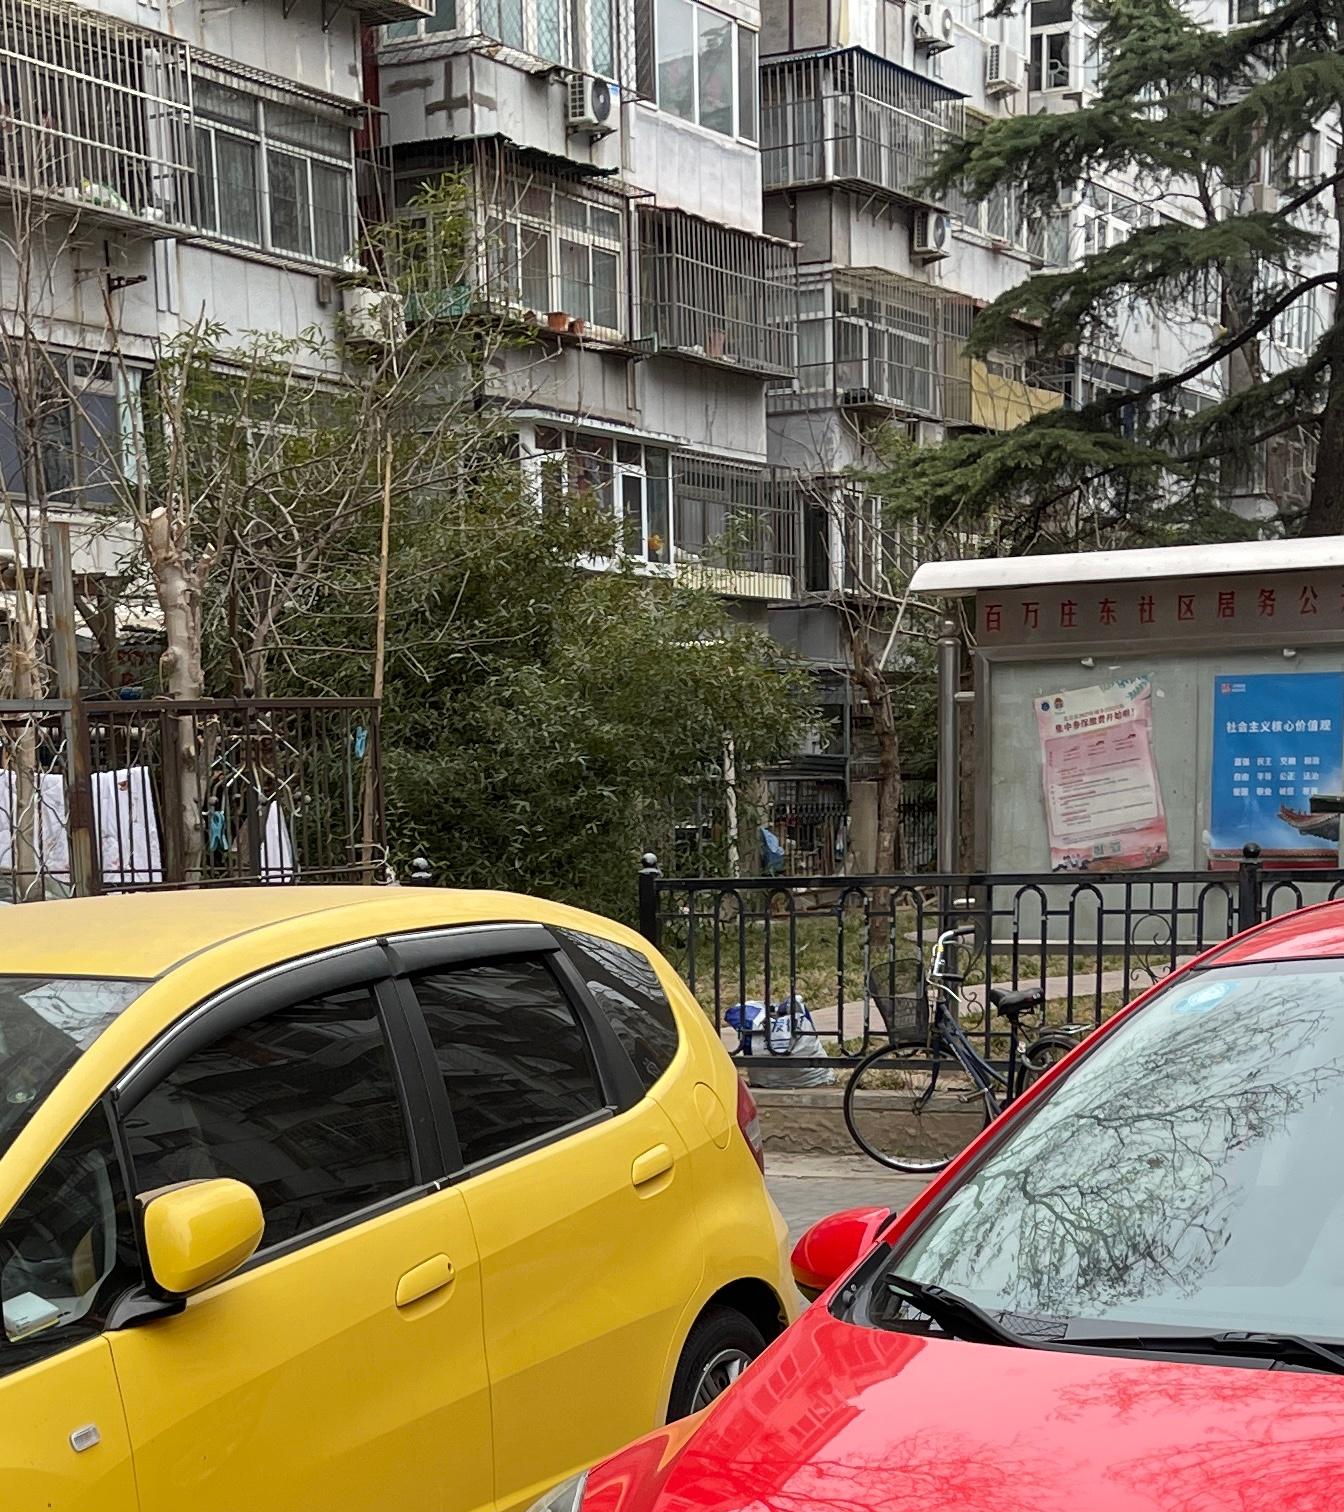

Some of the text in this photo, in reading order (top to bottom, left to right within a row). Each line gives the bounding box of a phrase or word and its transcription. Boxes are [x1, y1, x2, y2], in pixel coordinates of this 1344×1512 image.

[1226, 719, 1332, 733] 社会主义核心价值观
